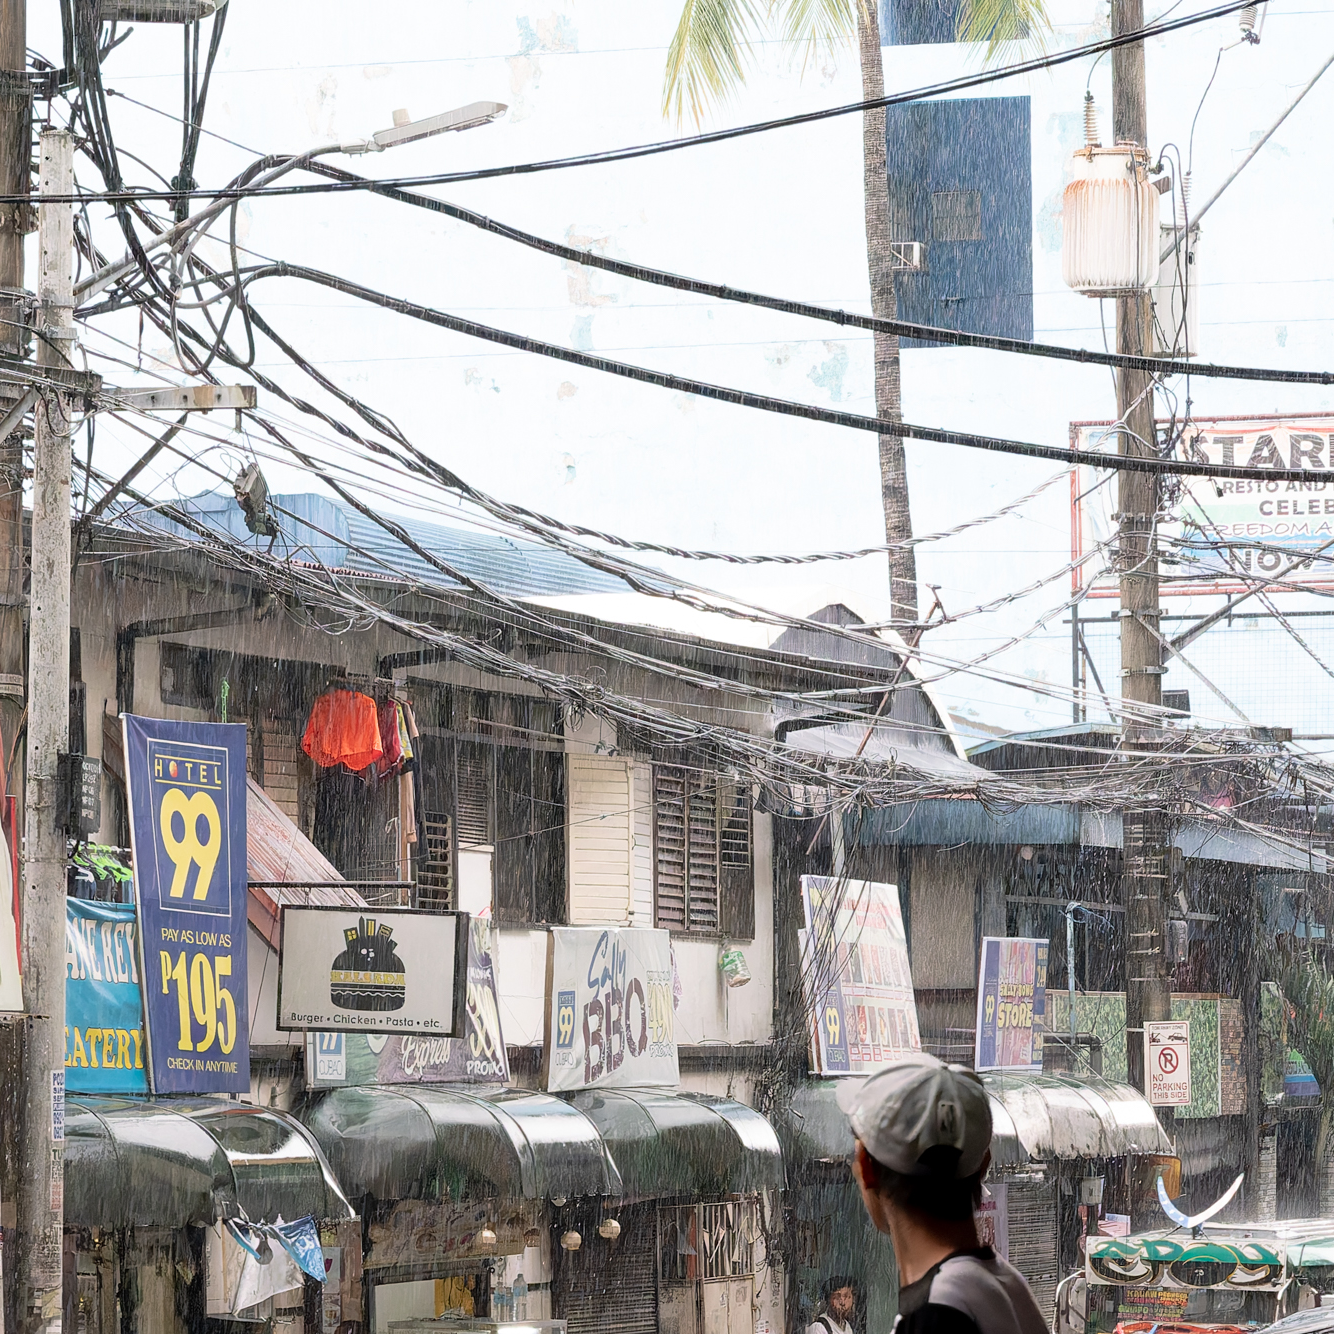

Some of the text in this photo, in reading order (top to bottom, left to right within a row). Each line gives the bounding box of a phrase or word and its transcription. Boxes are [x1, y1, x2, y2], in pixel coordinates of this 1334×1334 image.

[1223, 480, 1279, 494] RESTO
[1285, 480, 1326, 492] AND
[1201, 522, 1310, 538] FREEDOM
[160, 787, 221, 900] 99
[161, 927, 232, 948] PAY AS LOW AS
[588, 931, 626, 1000] Sally
[160, 950, 237, 1055] P195
[291, 1013, 442, 1028] Burger Chicken Pasta etc.
[998, 1001, 1033, 1029] STORE
[559, 1006, 574, 1044] 99
[167, 1057, 238, 1075] CHECK IN ANYTIME
[1153, 1073, 1164, 1082] NO
[1153, 1082, 1187, 1091] PARKING
[1171, 1091, 1187, 1099] SIDE
